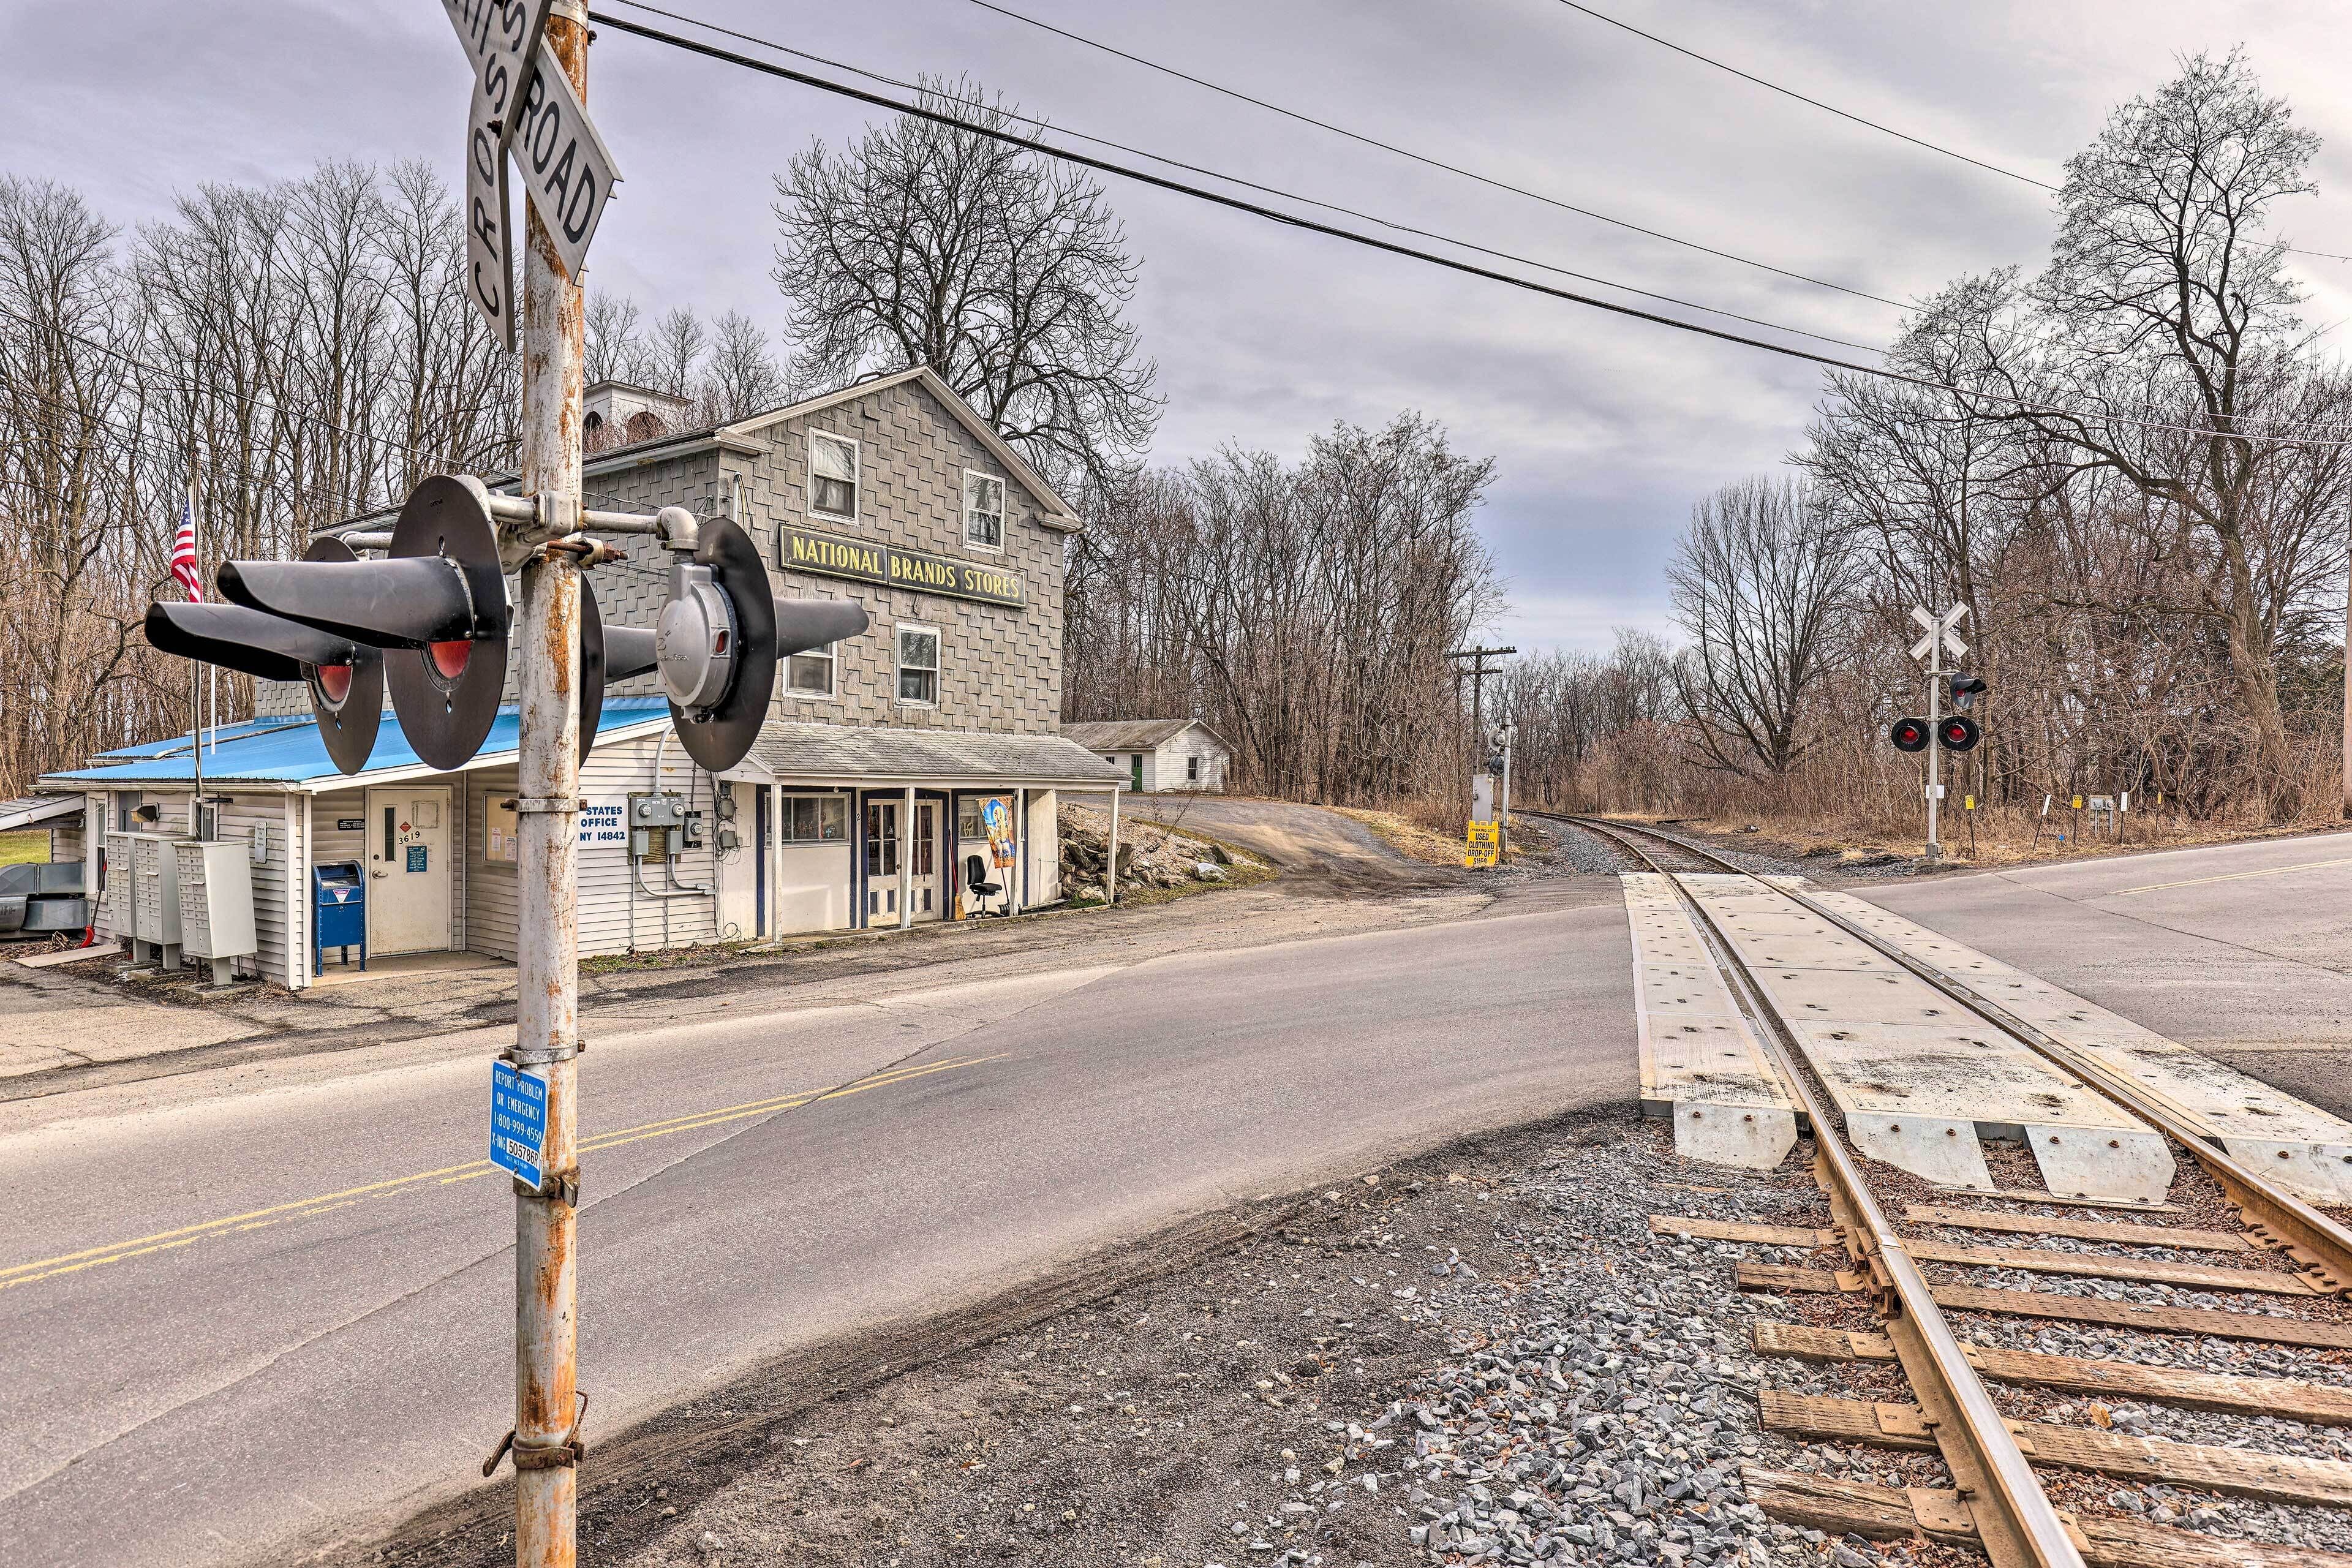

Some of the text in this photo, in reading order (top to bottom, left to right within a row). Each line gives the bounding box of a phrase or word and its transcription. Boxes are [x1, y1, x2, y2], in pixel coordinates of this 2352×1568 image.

[515, 65, 595, 244] ROAD
[793, 536, 1020, 598] NATIONAL BRANDS STORES
[581, 818, 617, 827] OFFICE
[586, 806, 622, 815] STATES
[399, 831, 420, 845] 3619
[580, 831, 625, 841] NY 14842
[496, 1070, 543, 1102] REPORT PROBLEM
[497, 1091, 540, 1122] OR EMERGENCY
[494, 1111, 542, 1144] 1-800-999-4559
[492, 1131, 506, 1150] X-ING
[509, 1140, 538, 1167] 505786R
